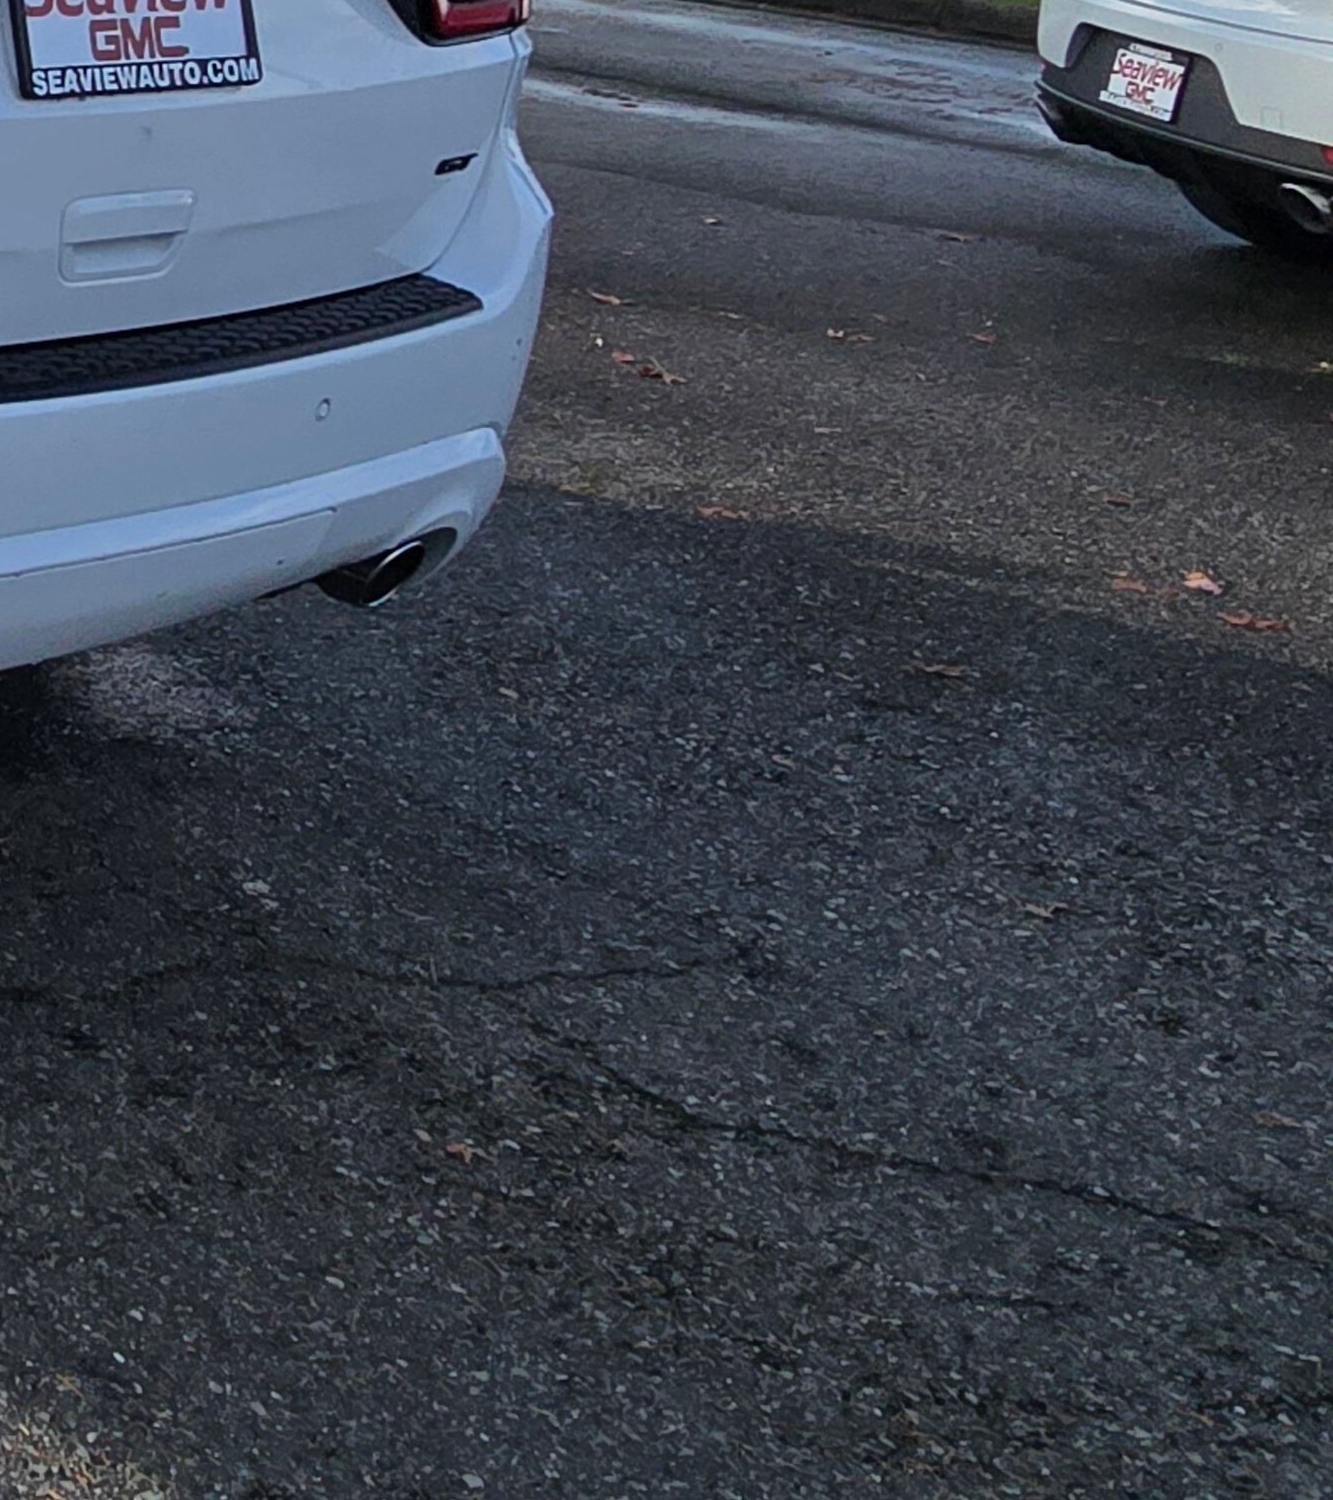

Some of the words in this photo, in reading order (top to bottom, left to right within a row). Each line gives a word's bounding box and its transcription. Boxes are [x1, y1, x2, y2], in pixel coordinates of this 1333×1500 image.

[88, 15, 190, 62] GMC
[32, 57, 259, 97] SEAVIEWAUTO.COM
[1113, 52, 1184, 91] Seaview
[1125, 80, 1155, 105] GMC
